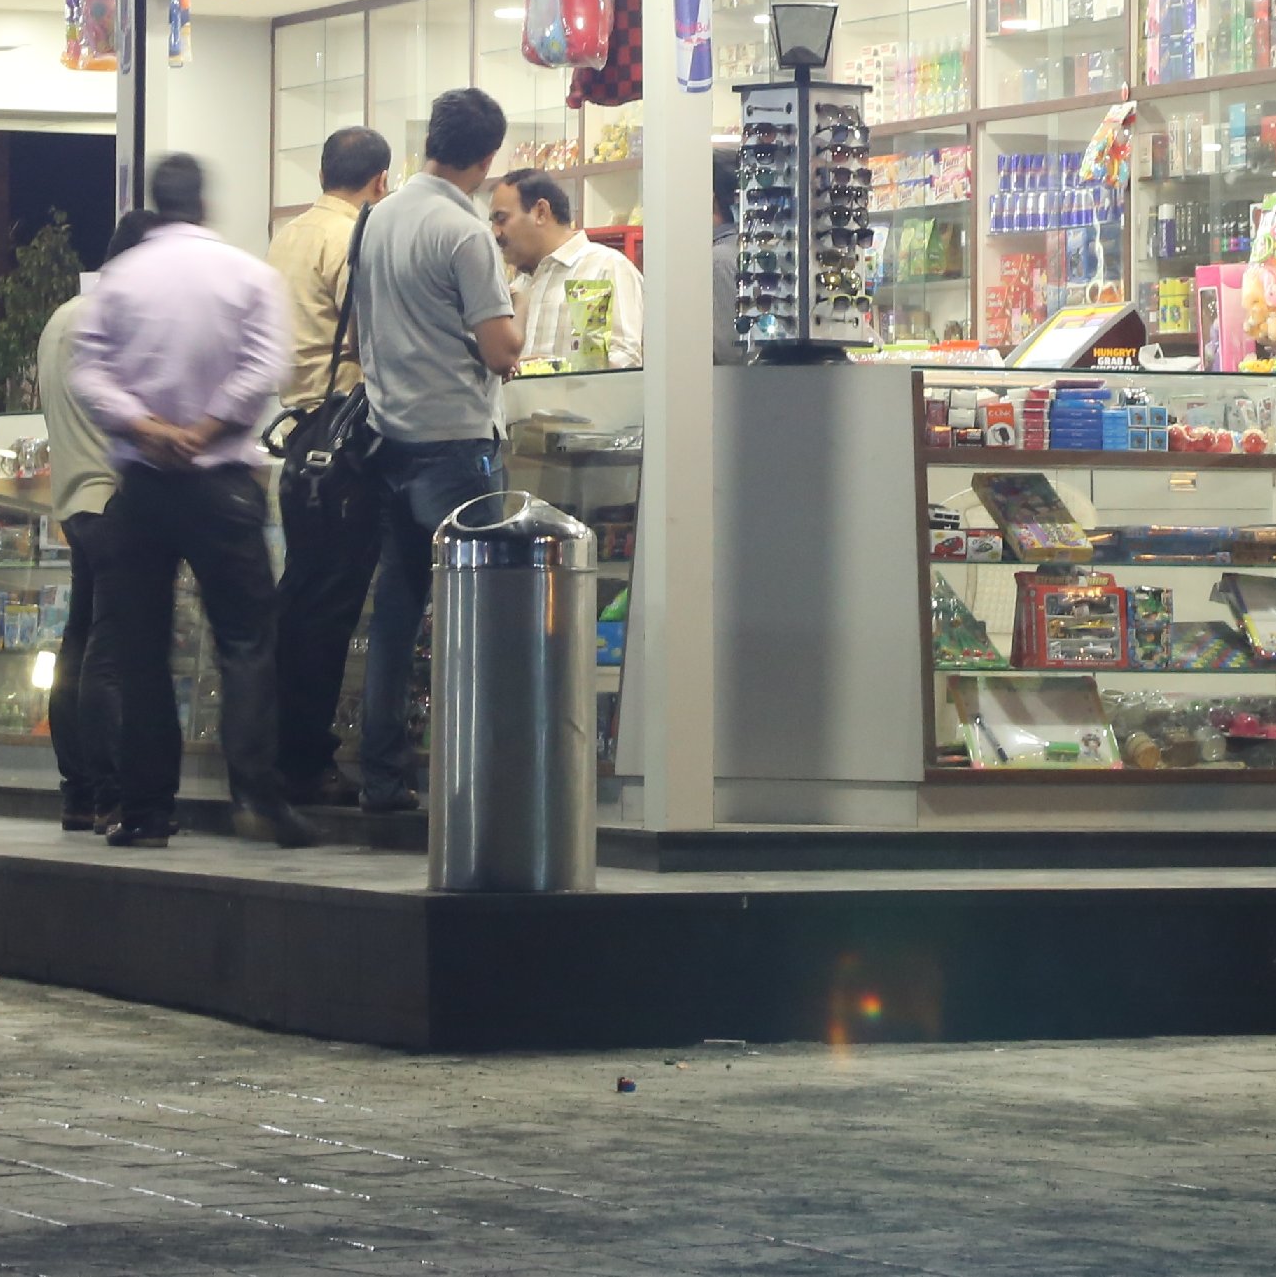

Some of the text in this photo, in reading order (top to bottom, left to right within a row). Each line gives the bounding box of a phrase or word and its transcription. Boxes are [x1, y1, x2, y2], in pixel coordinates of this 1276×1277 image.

[1092, 347, 1137, 358] HUNGRY?
[1097, 356, 1133, 366] GRAB A
